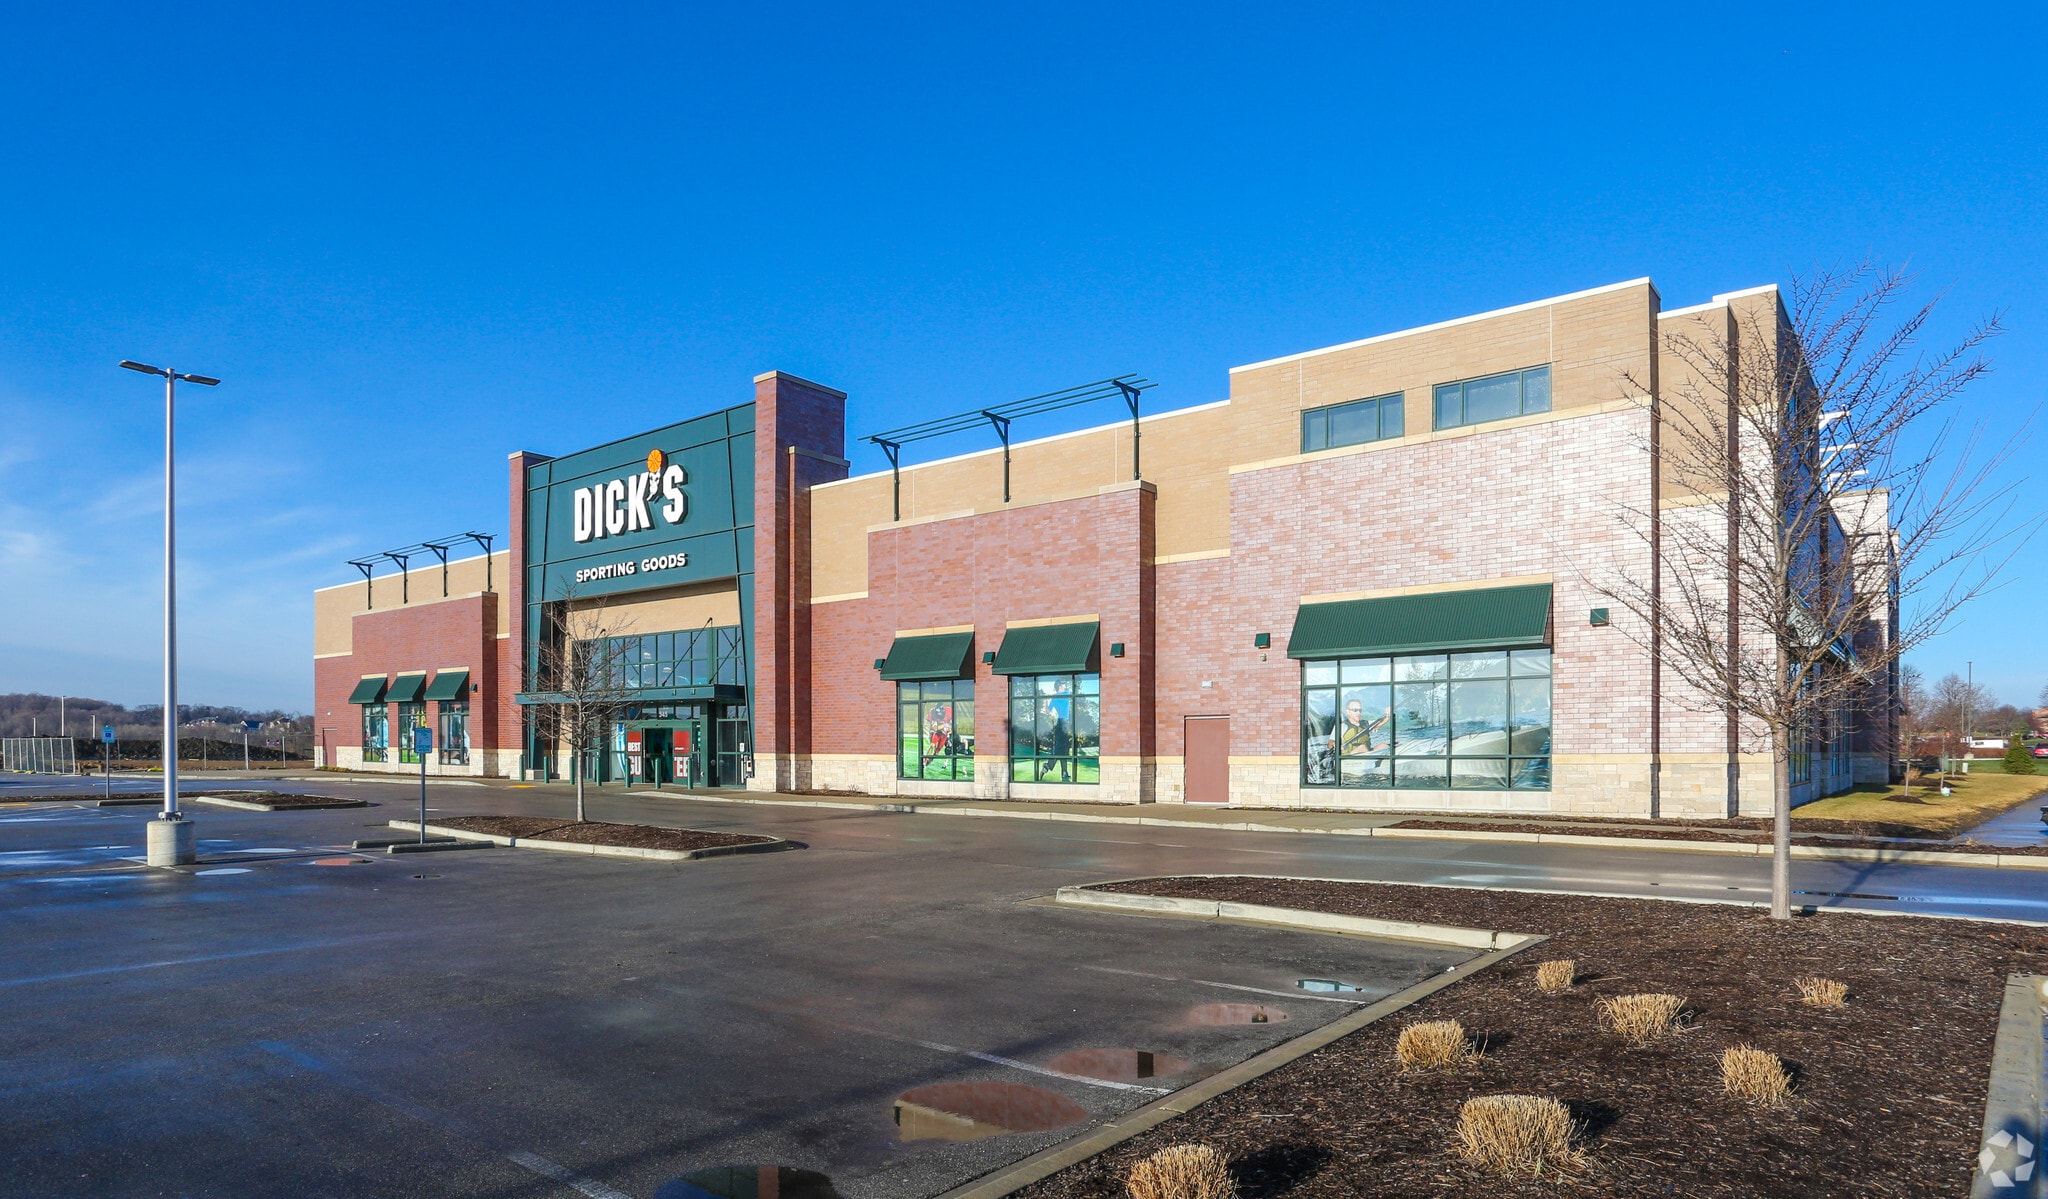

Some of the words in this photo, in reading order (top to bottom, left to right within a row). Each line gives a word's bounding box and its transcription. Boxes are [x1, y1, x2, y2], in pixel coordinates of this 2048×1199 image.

[574, 452, 686, 542] DICK'S
[576, 561, 636, 582] SPORTING
[641, 553, 686, 572] GOODS
